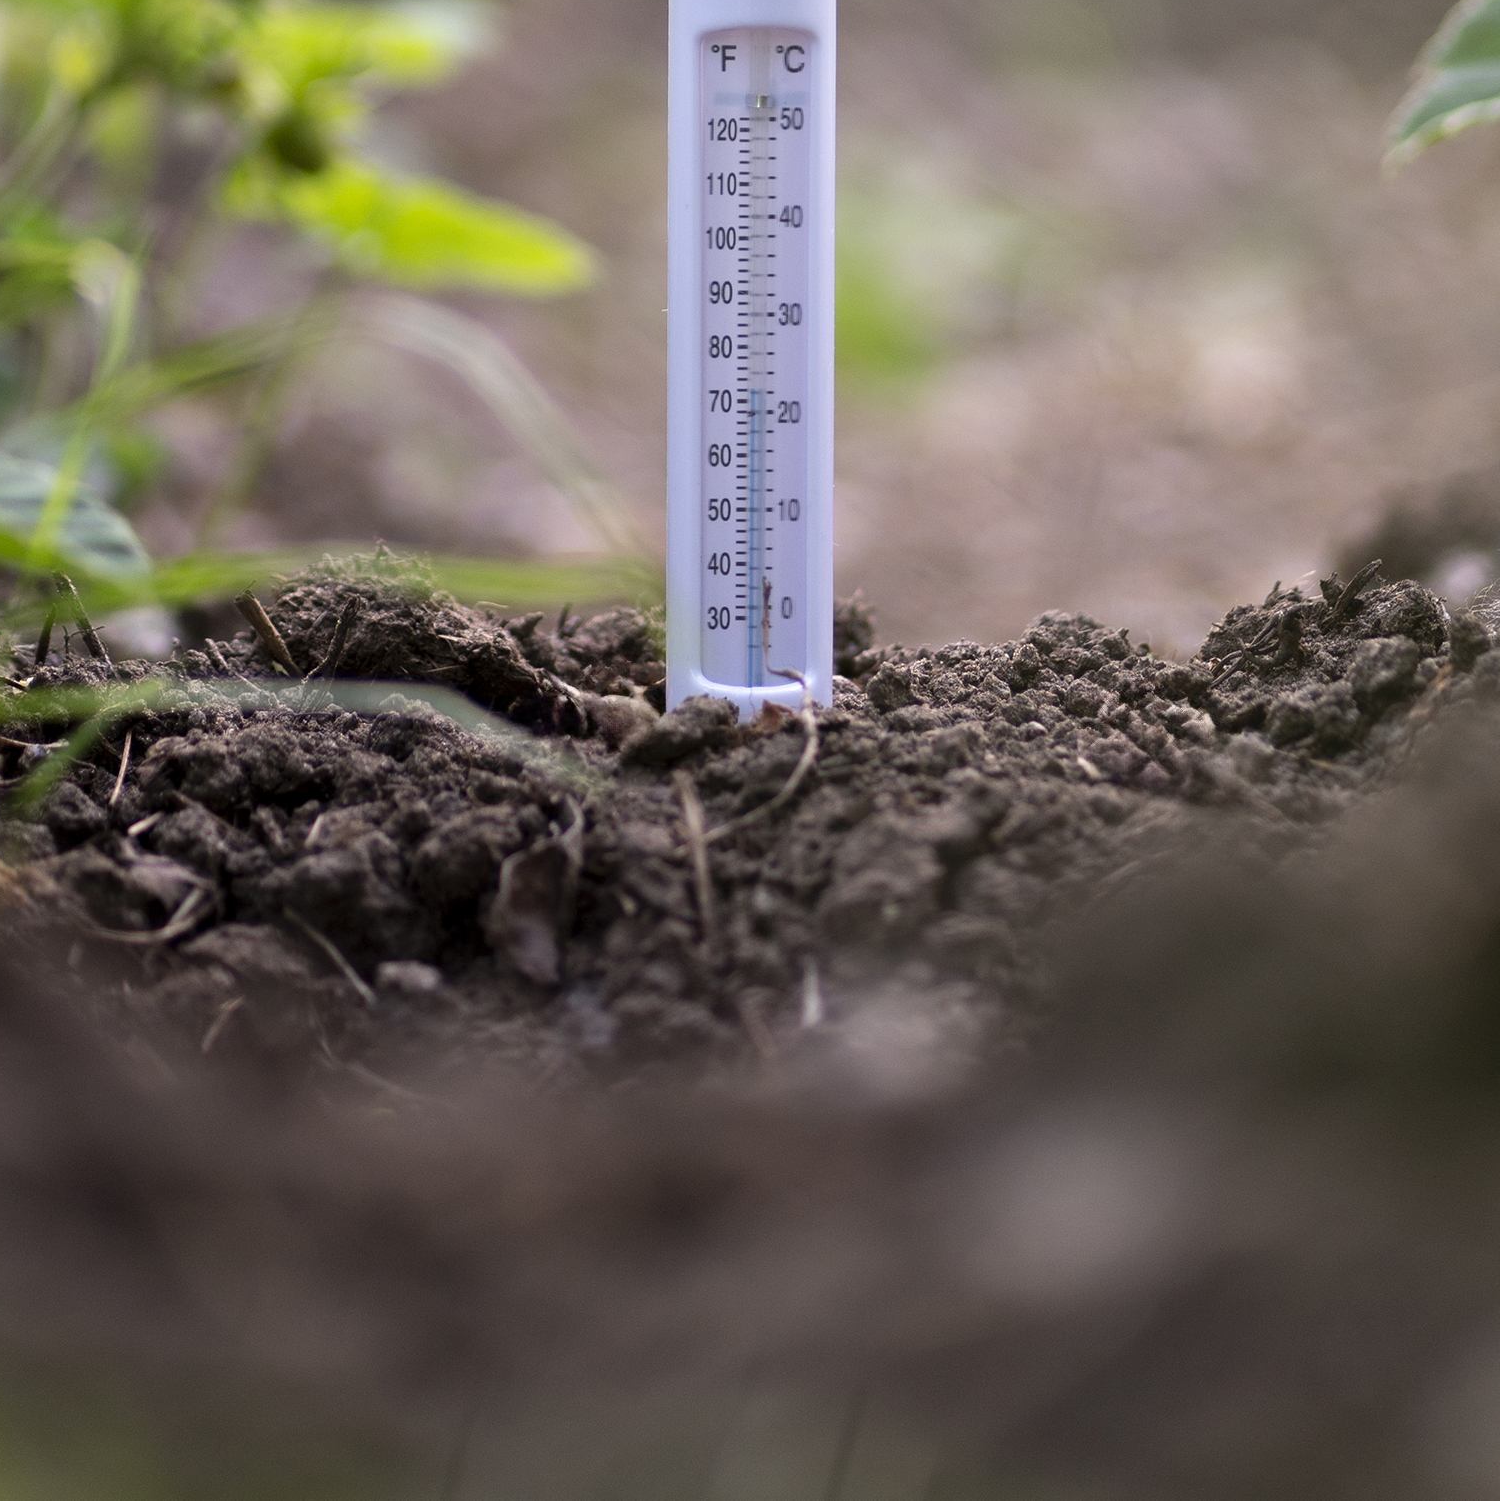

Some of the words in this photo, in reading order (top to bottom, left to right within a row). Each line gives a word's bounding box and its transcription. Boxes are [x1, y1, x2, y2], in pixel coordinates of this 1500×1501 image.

[711, 44, 737, 72] °F
[775, 44, 805, 73] °C
[707, 118, 738, 142] 120
[780, 107, 804, 130] 50
[707, 172, 737, 196] 110
[779, 205, 804, 228] 40
[706, 226, 737, 250] 100
[709, 280, 733, 304] 90
[778, 302, 802, 326] 30
[709, 335, 733, 359] 80
[708, 389, 732, 413] 70
[777, 400, 801, 424] 20
[708, 443, 732, 467] 60
[708, 498, 732, 521] 50
[778, 498, 800, 521] 10
[707, 552, 731, 576] 40
[707, 606, 731, 630] 30
[781, 596, 793, 619] 0
